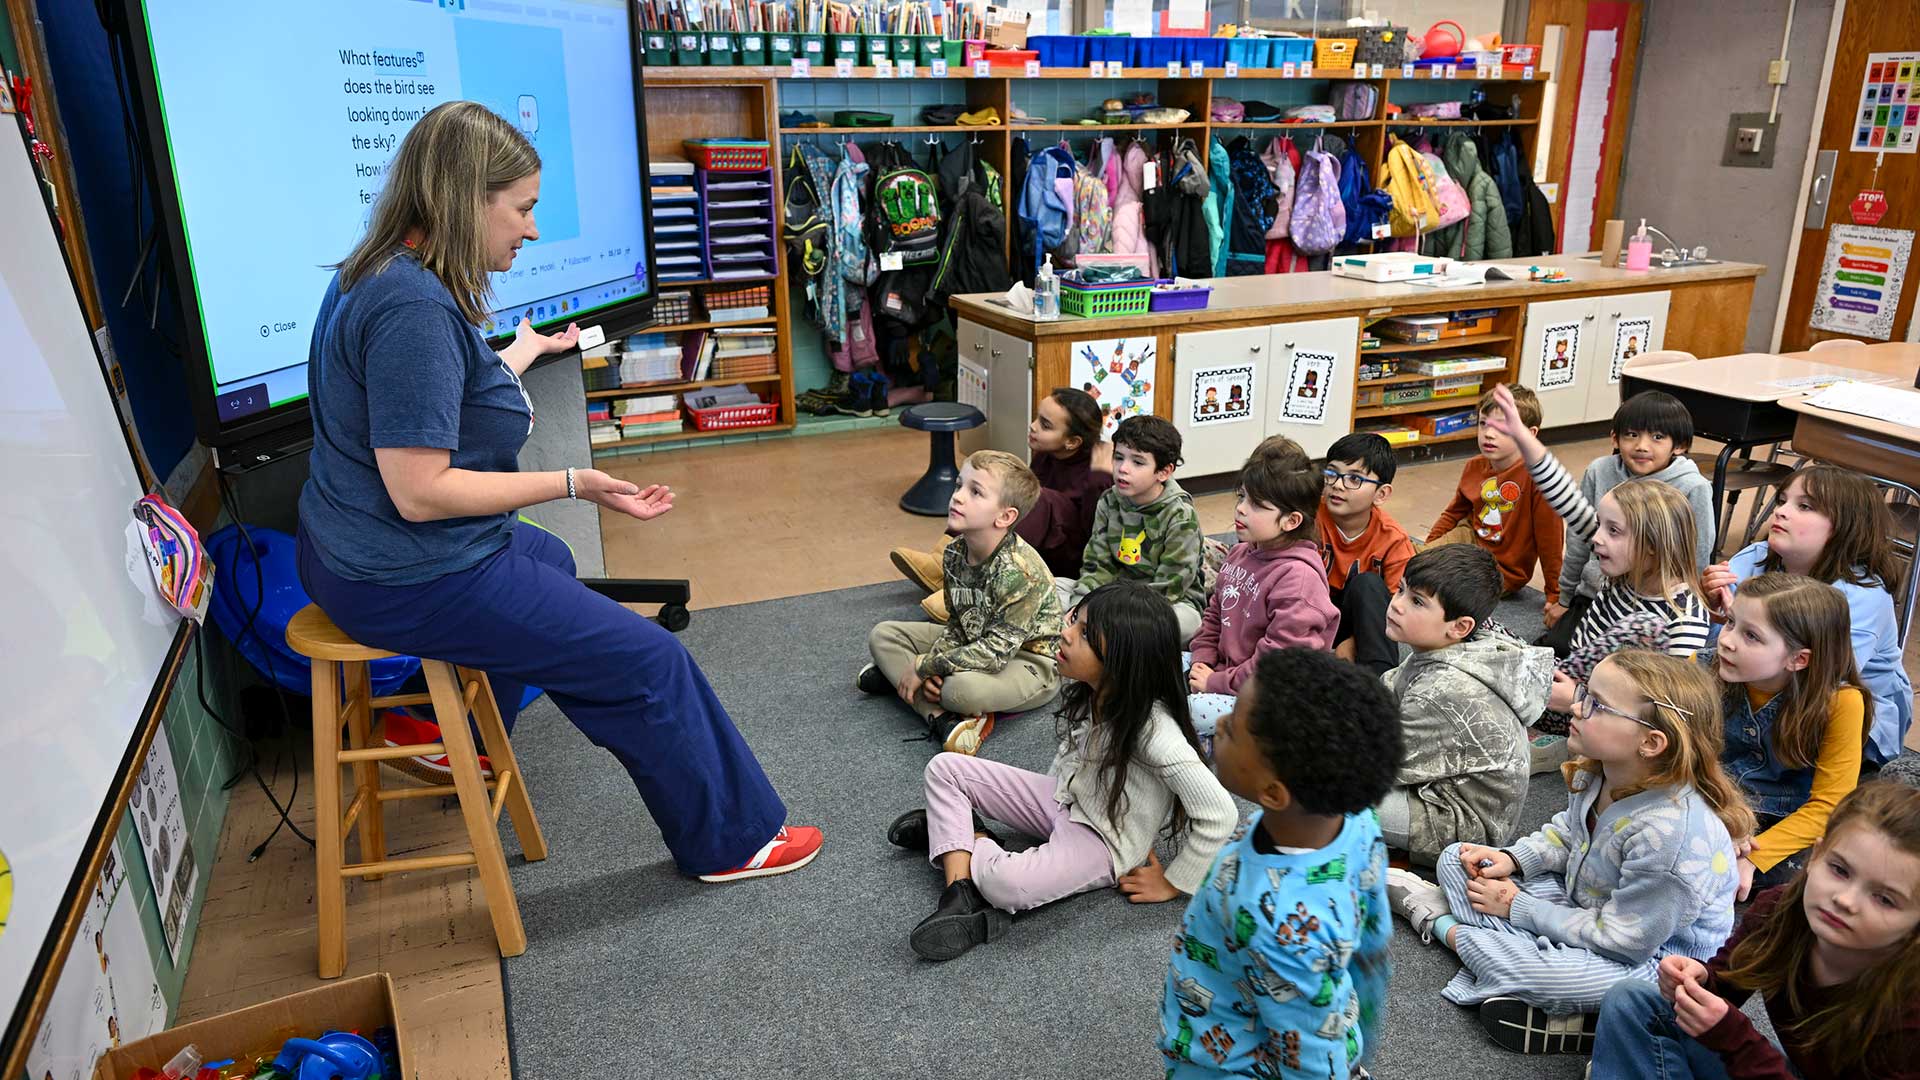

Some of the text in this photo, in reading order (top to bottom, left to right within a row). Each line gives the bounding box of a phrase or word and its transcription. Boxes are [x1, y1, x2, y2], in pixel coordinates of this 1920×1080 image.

[339, 49, 418, 68] What features
[344, 78, 435, 95] does the bird see
[347, 107, 390, 126] looking
[391, 108, 420, 121] down
[352, 133, 396, 152] the sky?
[355, 163, 381, 178] How
[1858, 193, 1884, 202] STOP!
[274, 321, 296, 333] Close
